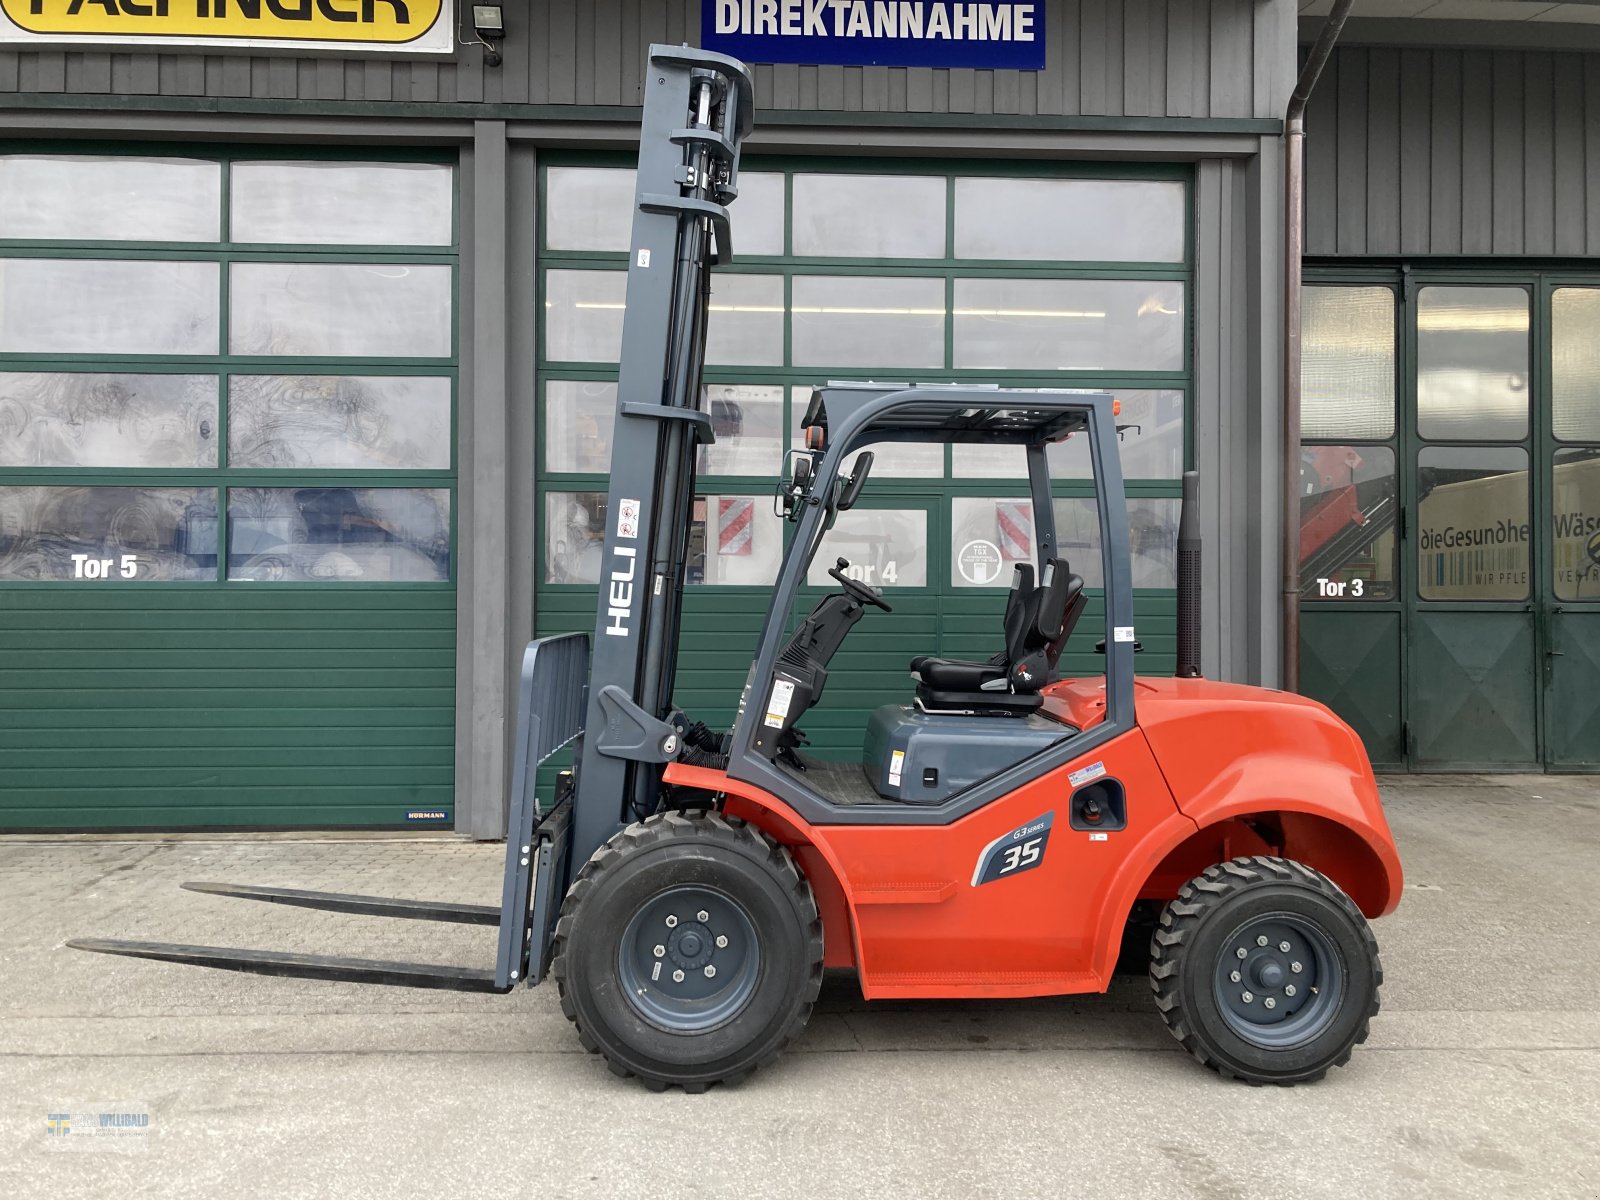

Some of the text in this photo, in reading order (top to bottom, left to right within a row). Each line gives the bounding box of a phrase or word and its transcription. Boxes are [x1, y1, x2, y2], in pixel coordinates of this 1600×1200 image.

[715, 0, 1035, 41] DIREKTANNAHME
[71, 554, 138, 578] Tor 5
[882, 561, 898, 583] 4
[1316, 578, 1364, 597] Tor 3
[1475, 573, 1494, 585] WIR
[605, 546, 637, 637] HELI
[1000, 837, 1043, 874] 35
